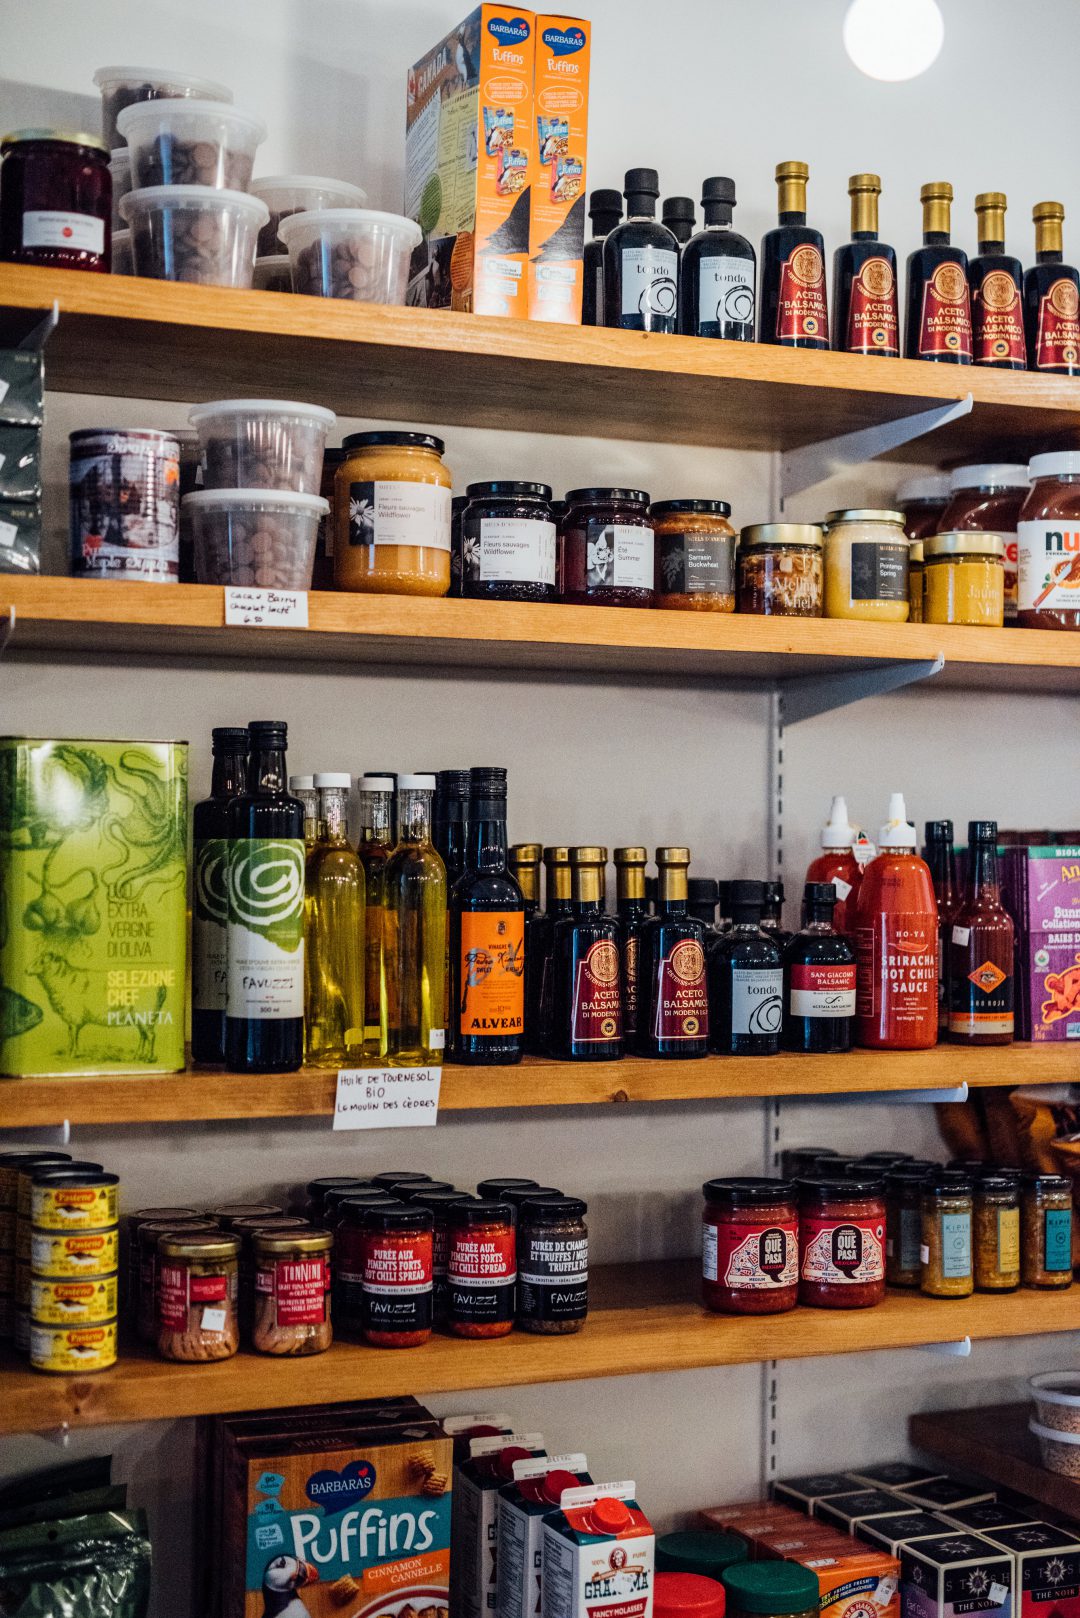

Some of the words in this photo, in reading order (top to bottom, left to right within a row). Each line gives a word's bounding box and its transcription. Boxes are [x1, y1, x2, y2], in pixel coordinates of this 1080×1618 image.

[492, 48, 524, 64] Puffins
[547, 58, 579, 74] Puffins
[714, 272, 747, 283] tondo
[795, 291, 822, 300] ACETO
[865, 304, 893, 312] ACETO
[938, 308, 965, 316] ACETO
[986, 316, 1014, 324] ACETO
[978, 325, 1022, 334] ALSAMICO
[1056, 322, 1080, 332] ACETO
[267, 592, 296, 608] Barry
[108, 902, 148, 918] EXTRA
[108, 921, 154, 938] VERGINE
[1048, 934, 1073, 944] BAIES
[882, 955, 934, 966] SRIRACHA
[108, 970, 175, 987] SELEZIONE
[882, 968, 904, 980] HOT
[910, 968, 934, 980] CHILI
[748, 986, 778, 994] tondo
[892, 982, 928, 992] SAUCE
[108, 988, 140, 1006] CHEF
[594, 990, 620, 999] ACETO
[675, 989, 704, 998] ACETO
[107, 1011, 172, 1025] PLANETA
[471, 1017, 522, 1028] ALVEAR
[382, 1070, 435, 1082] TOURNESOL
[456, 1241, 478, 1252] PURÉE
[480, 1243, 496, 1252] AUX
[530, 1240, 553, 1251] PURÉE
[555, 1242, 564, 1251] DE
[764, 1238, 782, 1254] QUE
[838, 1236, 856, 1250] QUE
[374, 1248, 396, 1260] PURÉE
[398, 1250, 414, 1260] AUX
[450, 1251, 479, 1263] PIMENTS
[480, 1253, 503, 1263] FORTS
[530, 1251, 538, 1260] ET
[540, 1251, 571, 1262] TRUFFES
[764, 1253, 782, 1264] PASA
[838, 1250, 857, 1260] PASA
[368, 1259, 398, 1270] PIMENTS
[399, 1260, 422, 1270] FORTS
[459, 1263, 478, 1274] CHILI
[480, 1262, 507, 1274] SPREAD
[548, 1262, 579, 1272] TRUFFLE
[284, 1263, 320, 1283] TONNINO
[377, 1272, 397, 1282] CHILI
[399, 1270, 425, 1282] SPREAD
[453, 1292, 498, 1305] FAVUZZI
[310, 1477, 371, 1495] BARBARAS
[290, 1508, 437, 1564] Puffins
[368, 1559, 422, 1579] CINNAMON
[390, 1563, 443, 1583] CANNELLE
[834, 1583, 852, 1594] FRIDGE
[1036, 1590, 1052, 1600] THÉ
[1054, 1589, 1075, 1598] NOIR
[593, 1608, 613, 1618] FANCY
[614, 1603, 643, 1616] MOLASSES
[958, 1602, 974, 1612] THÉ
